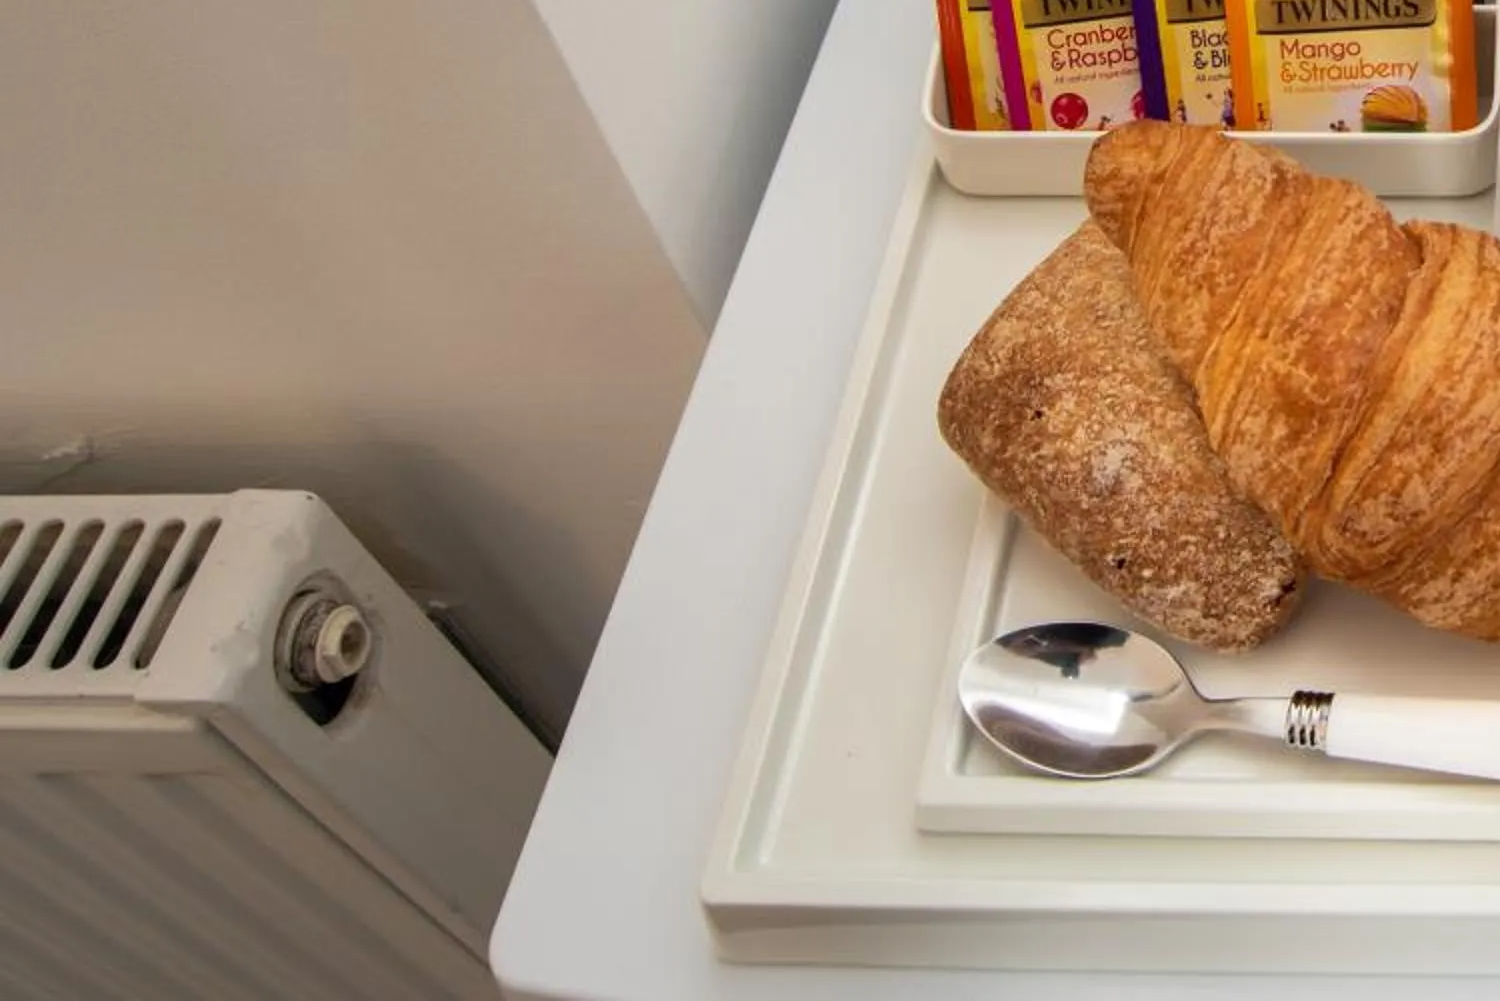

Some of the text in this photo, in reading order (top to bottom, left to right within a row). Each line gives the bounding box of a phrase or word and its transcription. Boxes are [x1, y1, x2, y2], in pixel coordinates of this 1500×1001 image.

[1047, 24, 1136, 50] Cranber
[1279, 38, 1361, 61] Mango
[1068, 44, 1139, 69] Raspb
